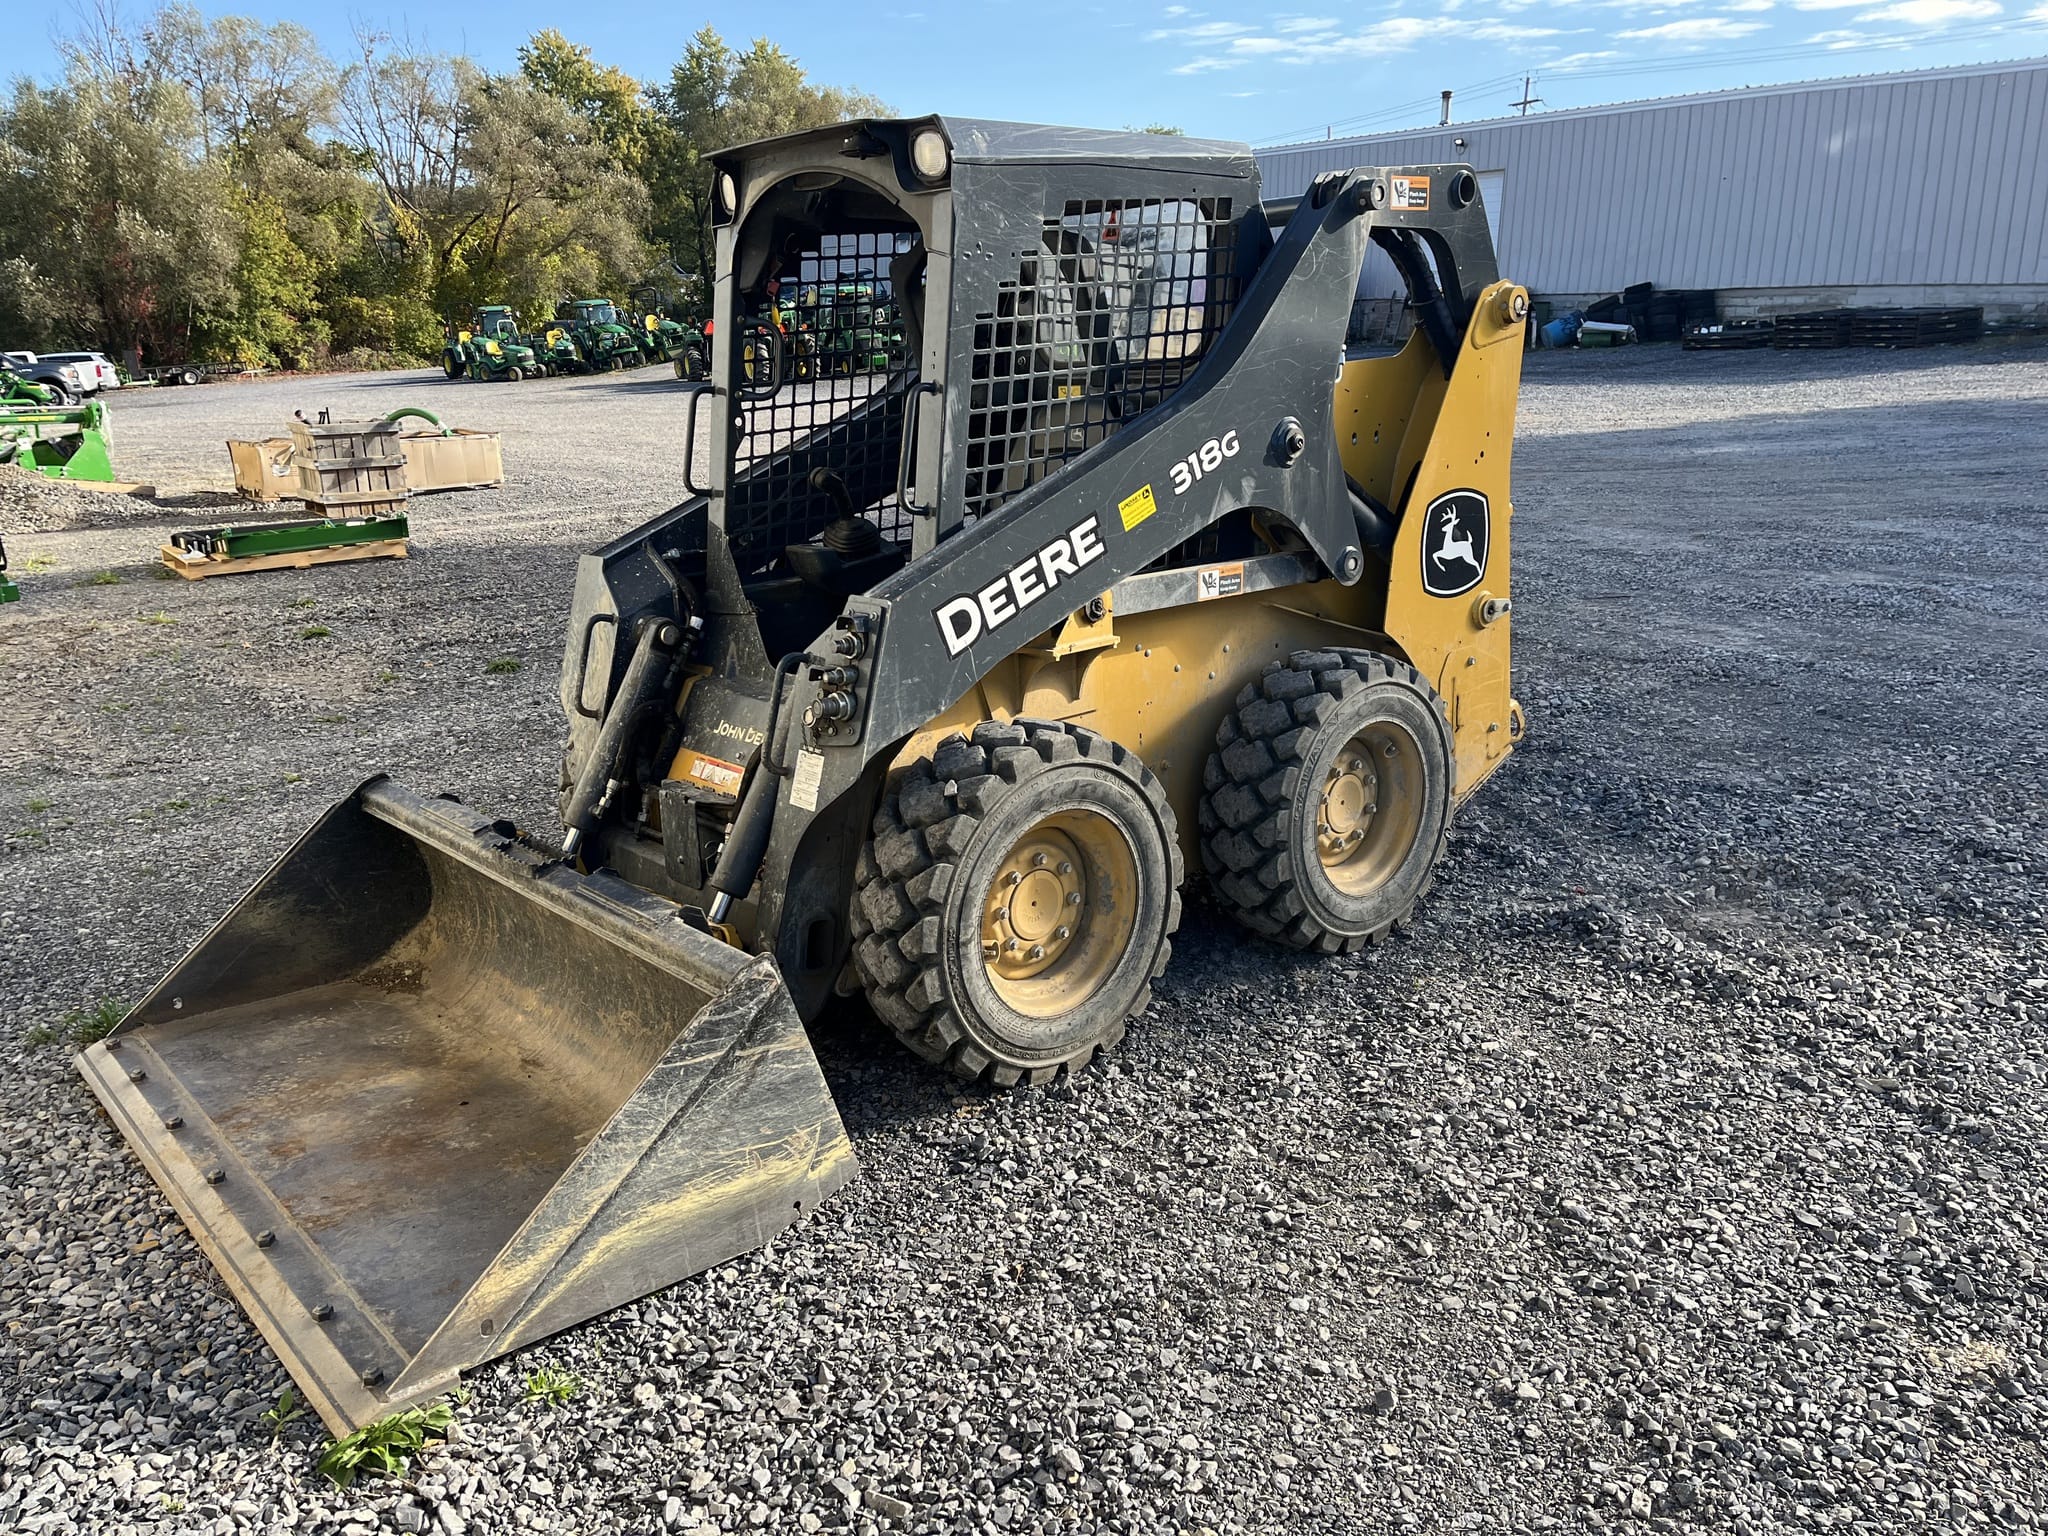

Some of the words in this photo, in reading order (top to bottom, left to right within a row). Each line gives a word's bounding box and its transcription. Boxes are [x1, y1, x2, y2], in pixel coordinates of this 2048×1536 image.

[1169, 430, 1241, 495] 318G
[935, 515, 1106, 657] DEERE
[713, 719, 746, 740] JOHN
